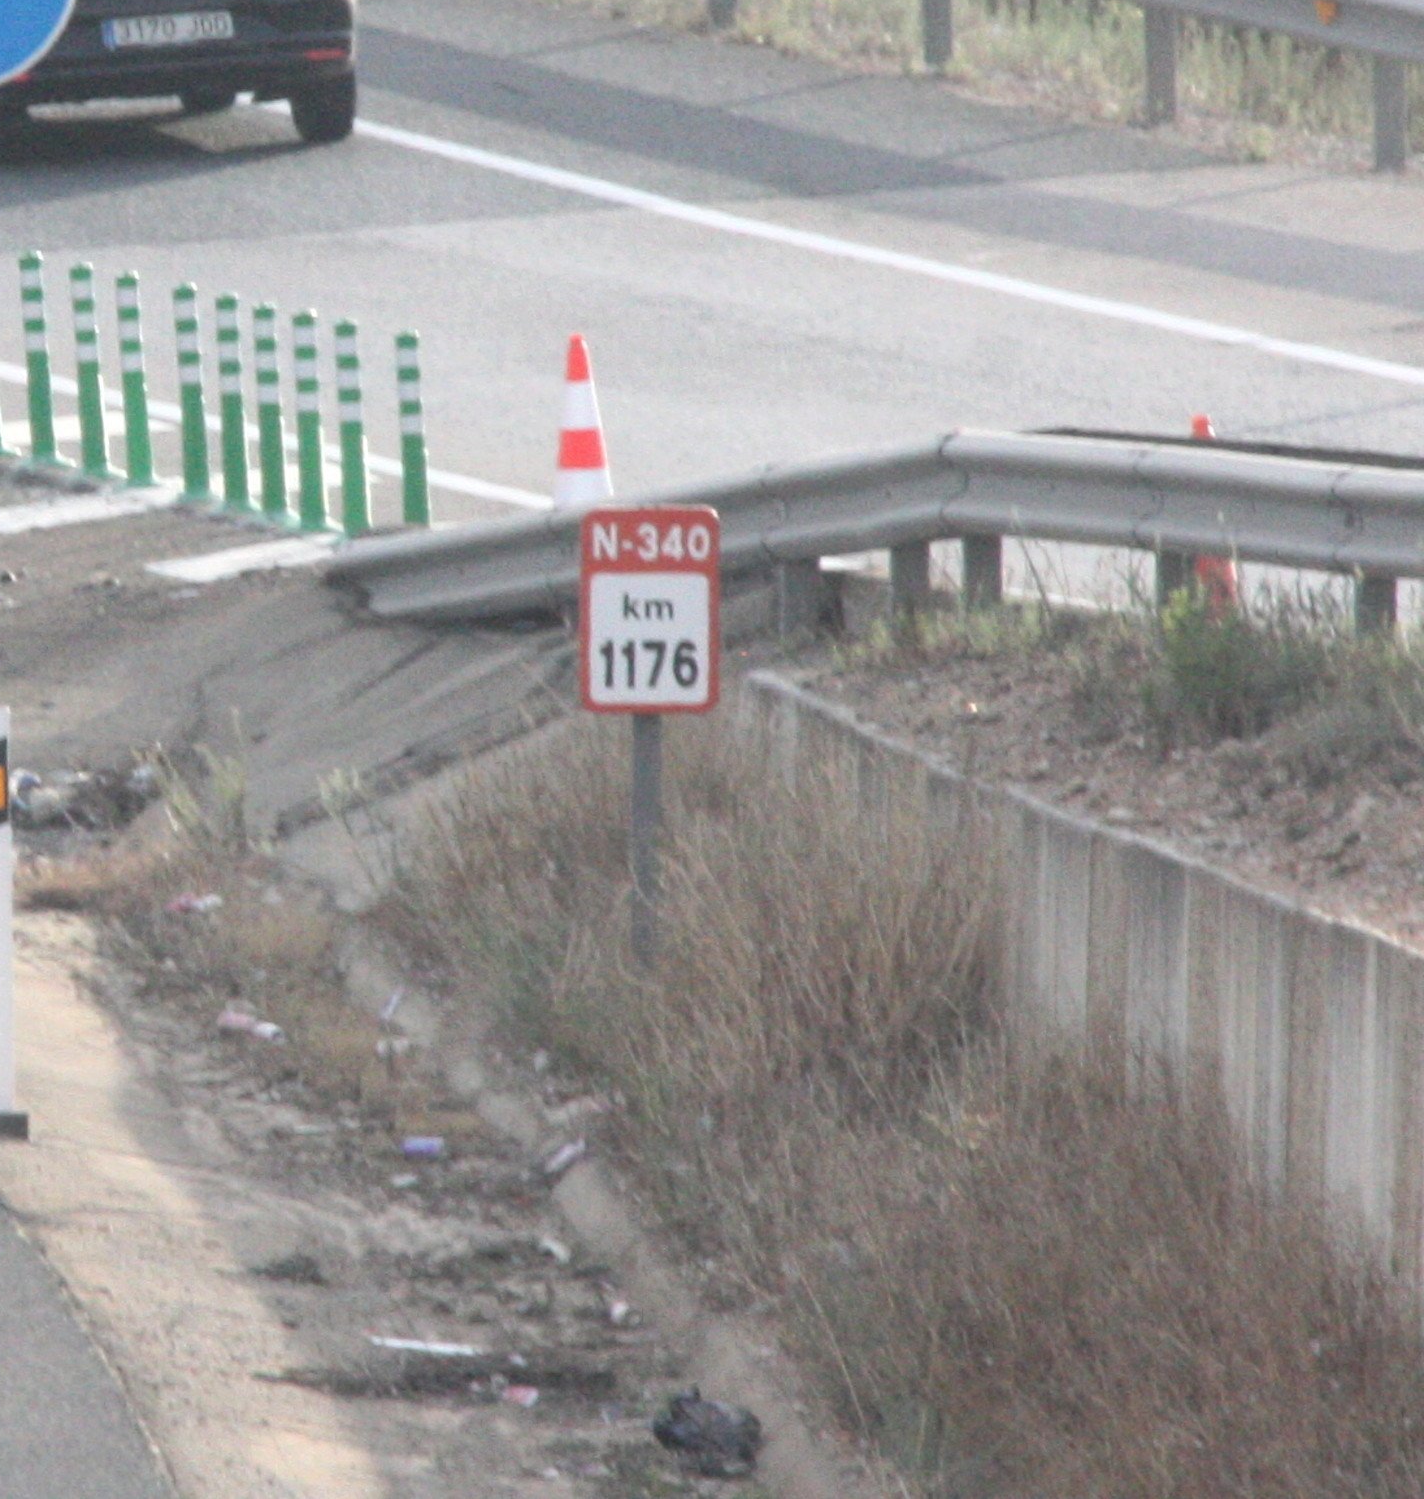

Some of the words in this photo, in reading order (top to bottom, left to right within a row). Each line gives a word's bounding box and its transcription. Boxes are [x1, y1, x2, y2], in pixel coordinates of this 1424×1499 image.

[591, 522, 711, 562] N-340
[622, 591, 674, 621] km
[600, 639, 699, 689] 1176
